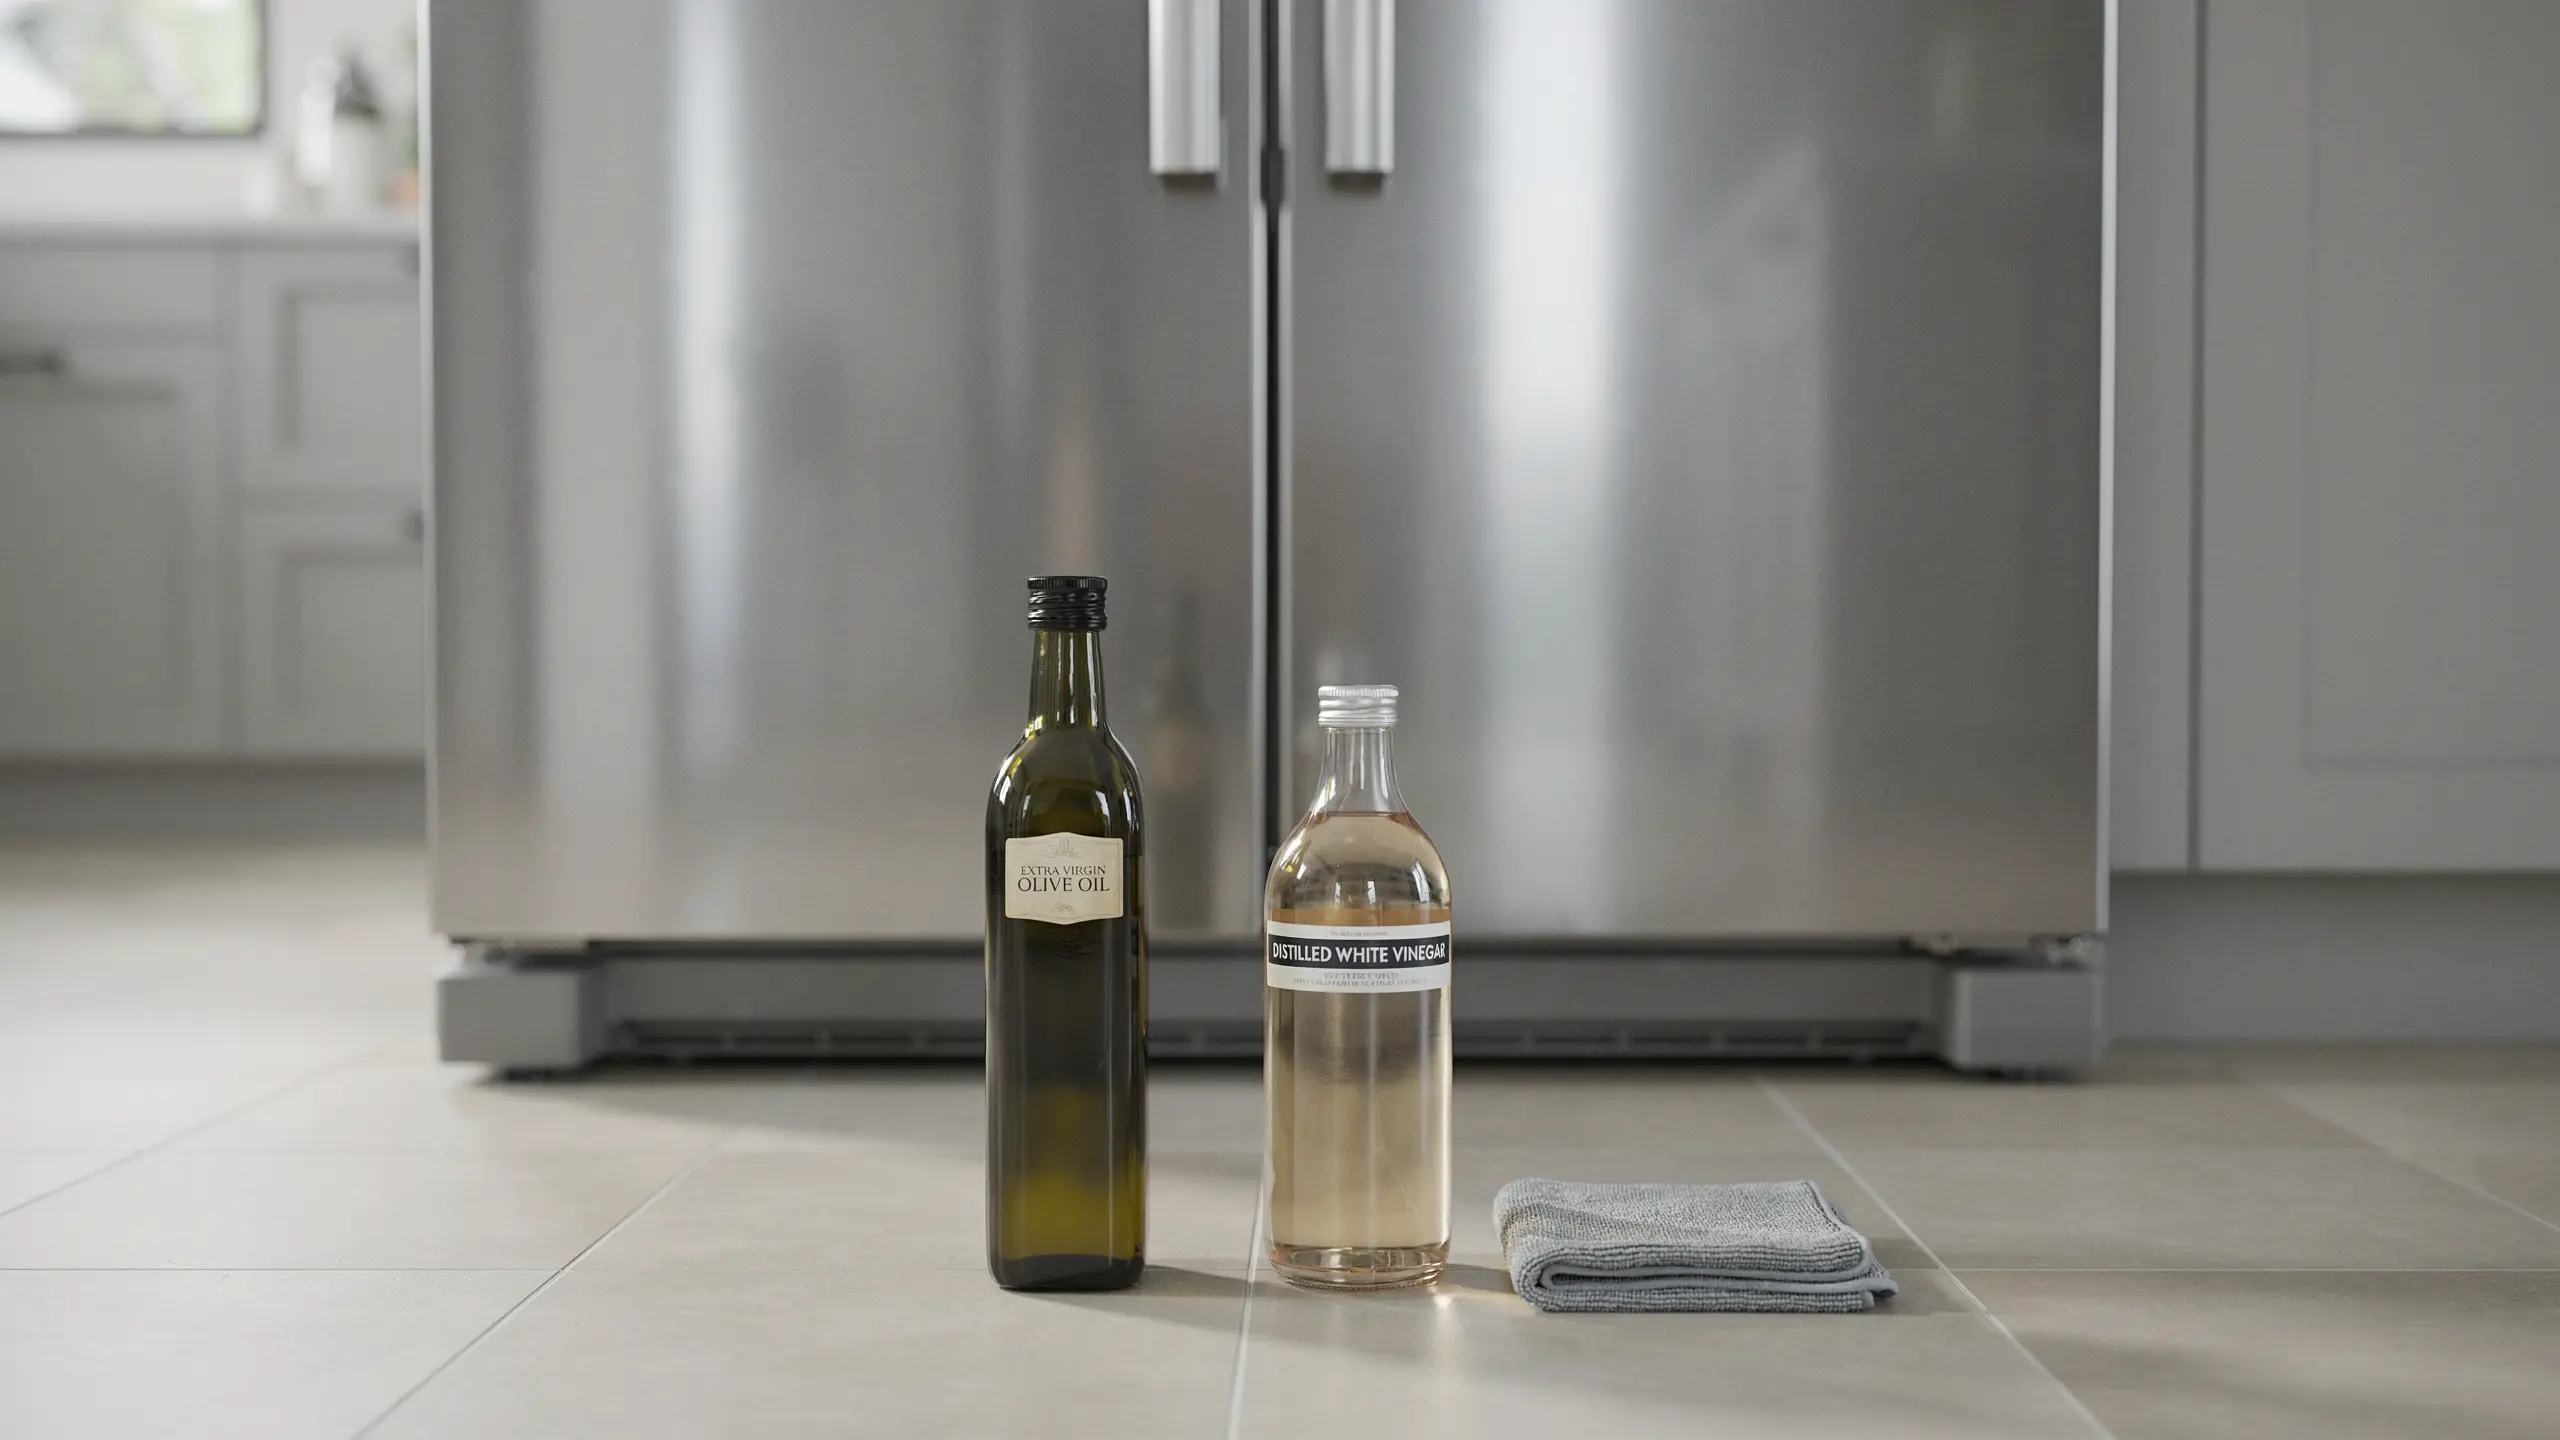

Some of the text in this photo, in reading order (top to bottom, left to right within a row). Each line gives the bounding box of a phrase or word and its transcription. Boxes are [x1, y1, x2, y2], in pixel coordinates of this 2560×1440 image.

[1021, 865, 1107, 876] EXTRA VIRGIN
[1018, 877, 1111, 892] OLIVE OIL
[1272, 942, 1446, 963] DISTILLED WHITE VINEGAR
